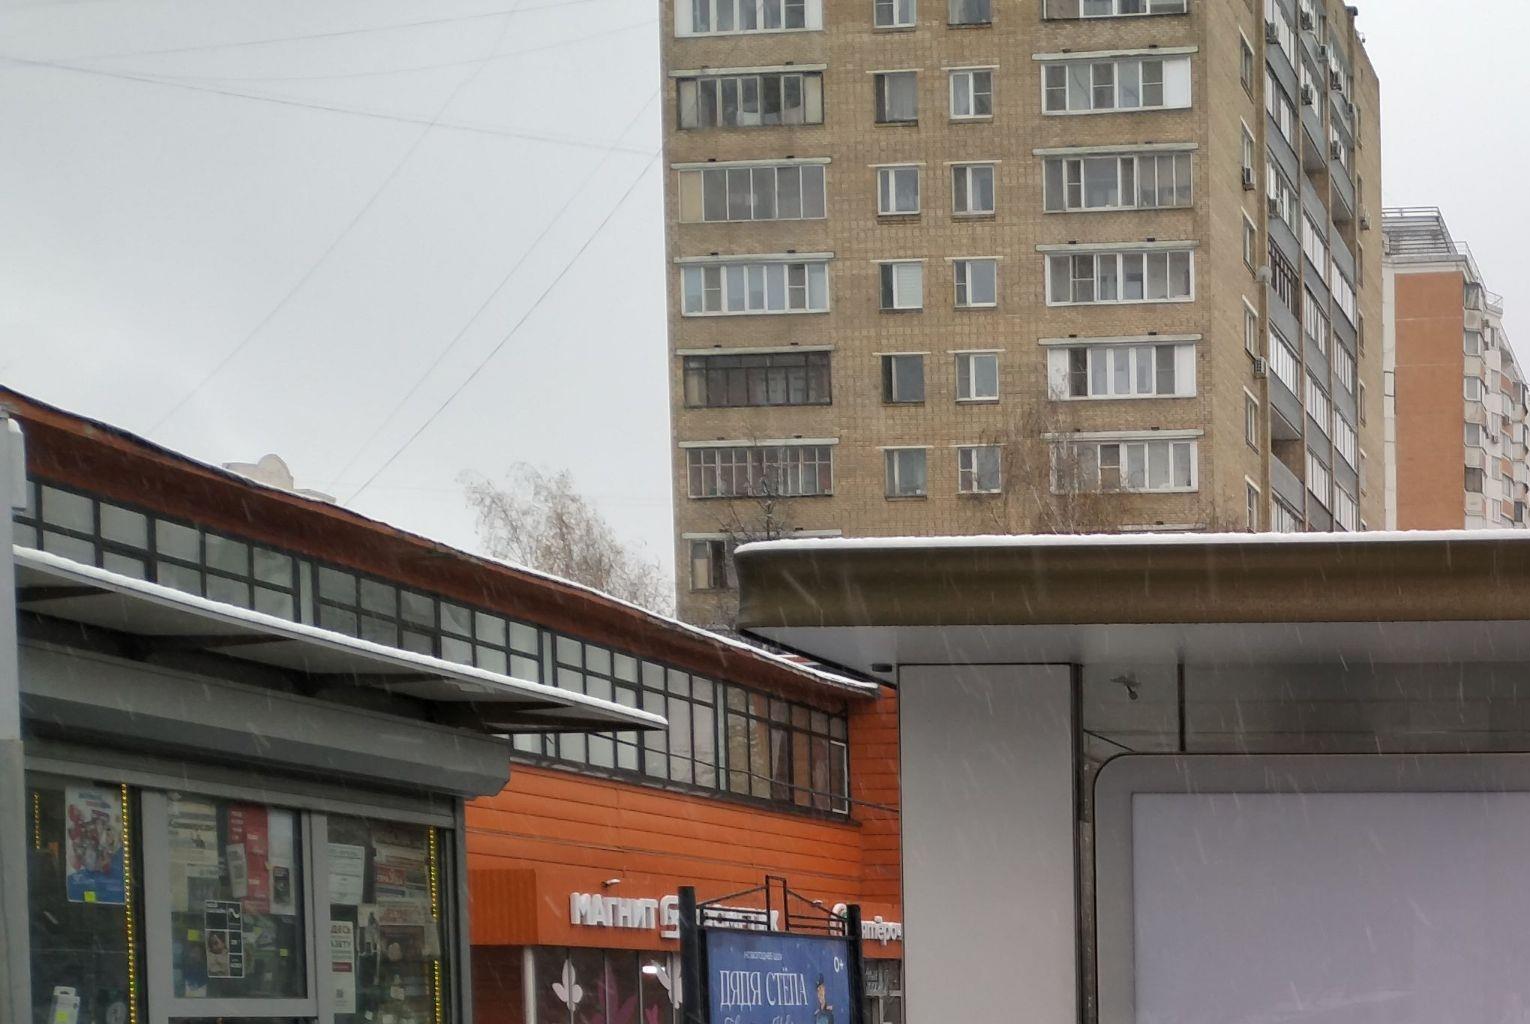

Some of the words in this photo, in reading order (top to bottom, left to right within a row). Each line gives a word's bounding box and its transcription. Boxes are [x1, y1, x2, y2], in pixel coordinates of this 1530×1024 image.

[570, 892, 658, 929] МАГНИТ
[833, 956, 844, 973] 0+
[719, 970, 762, 1013] ДЯДЯ
[765, 967, 808, 1006] СТЁПА
